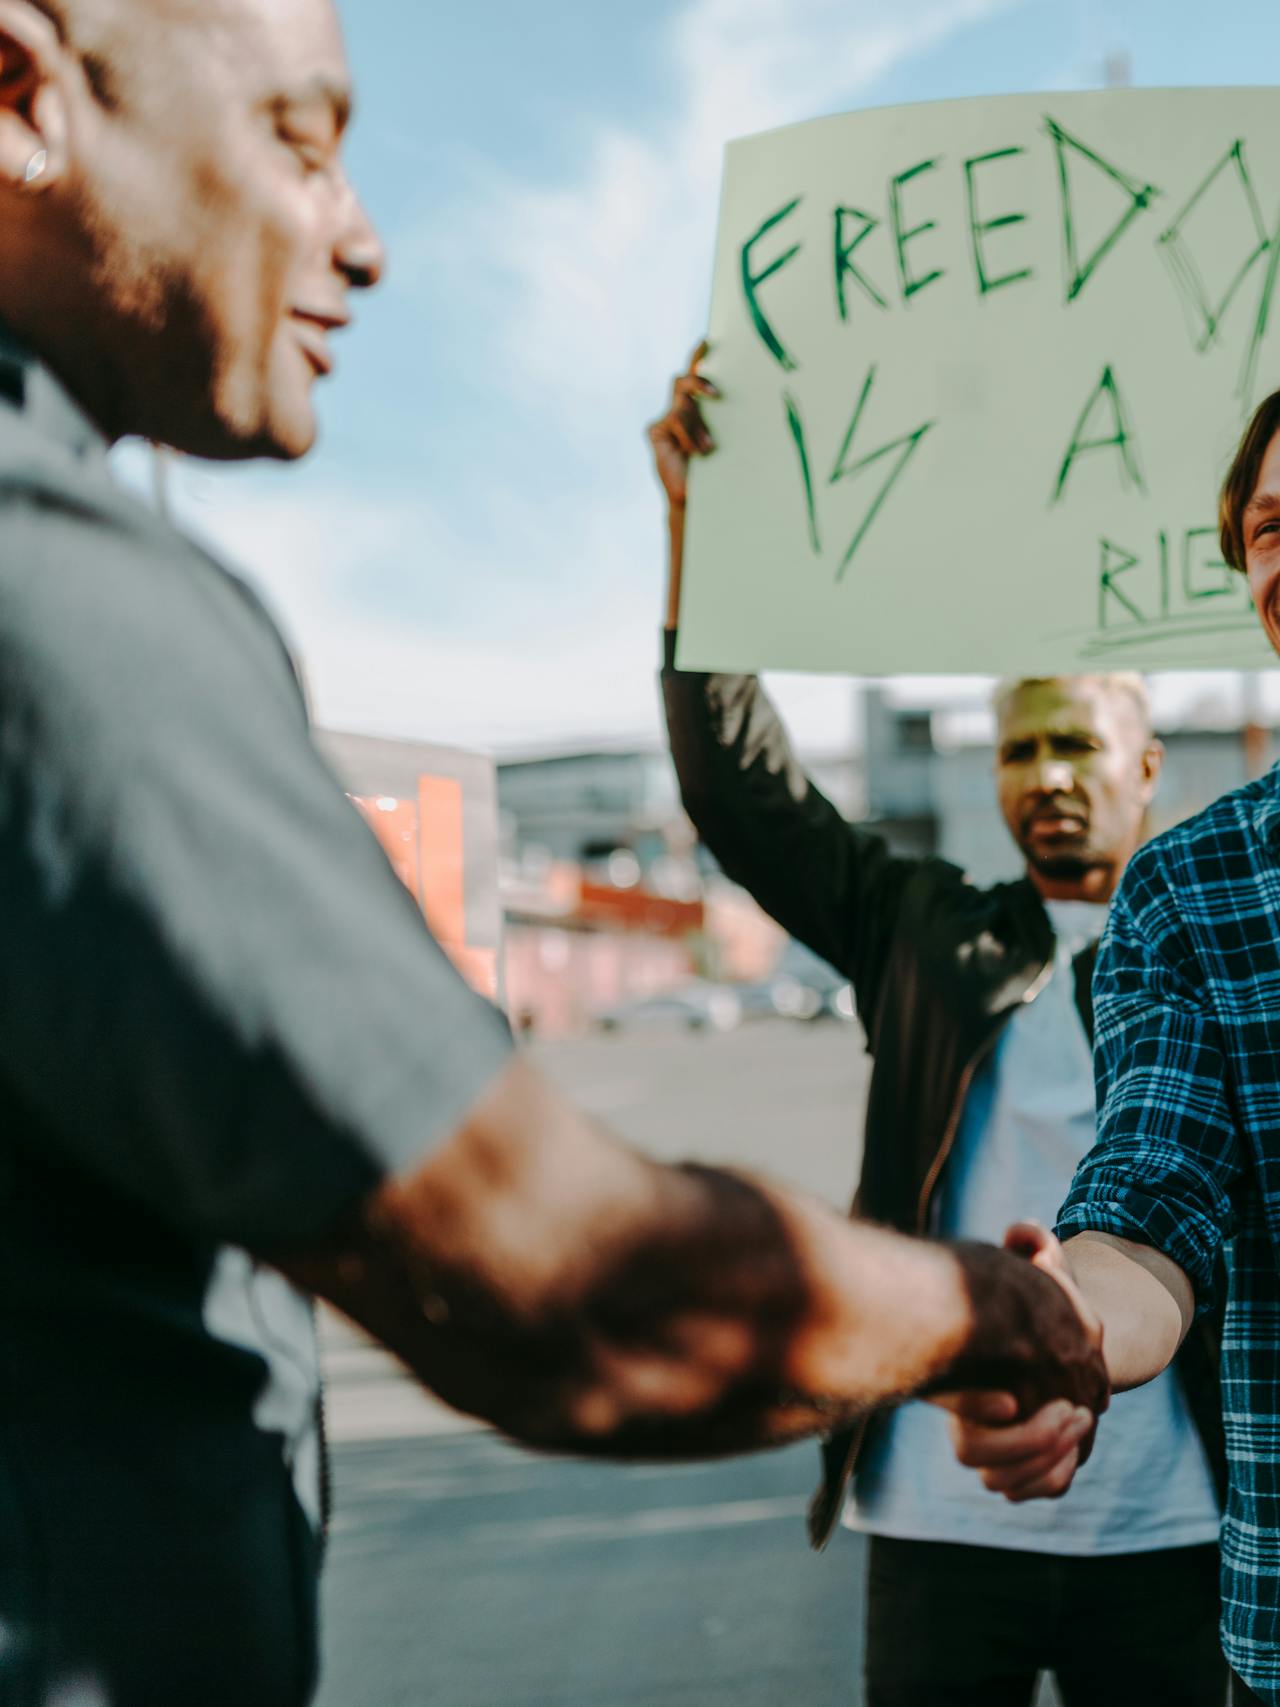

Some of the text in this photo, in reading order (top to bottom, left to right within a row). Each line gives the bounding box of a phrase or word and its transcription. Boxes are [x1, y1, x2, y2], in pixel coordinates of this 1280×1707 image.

[784, 363, 1148, 583] IS A
[1098, 530, 1257, 628] RIG
